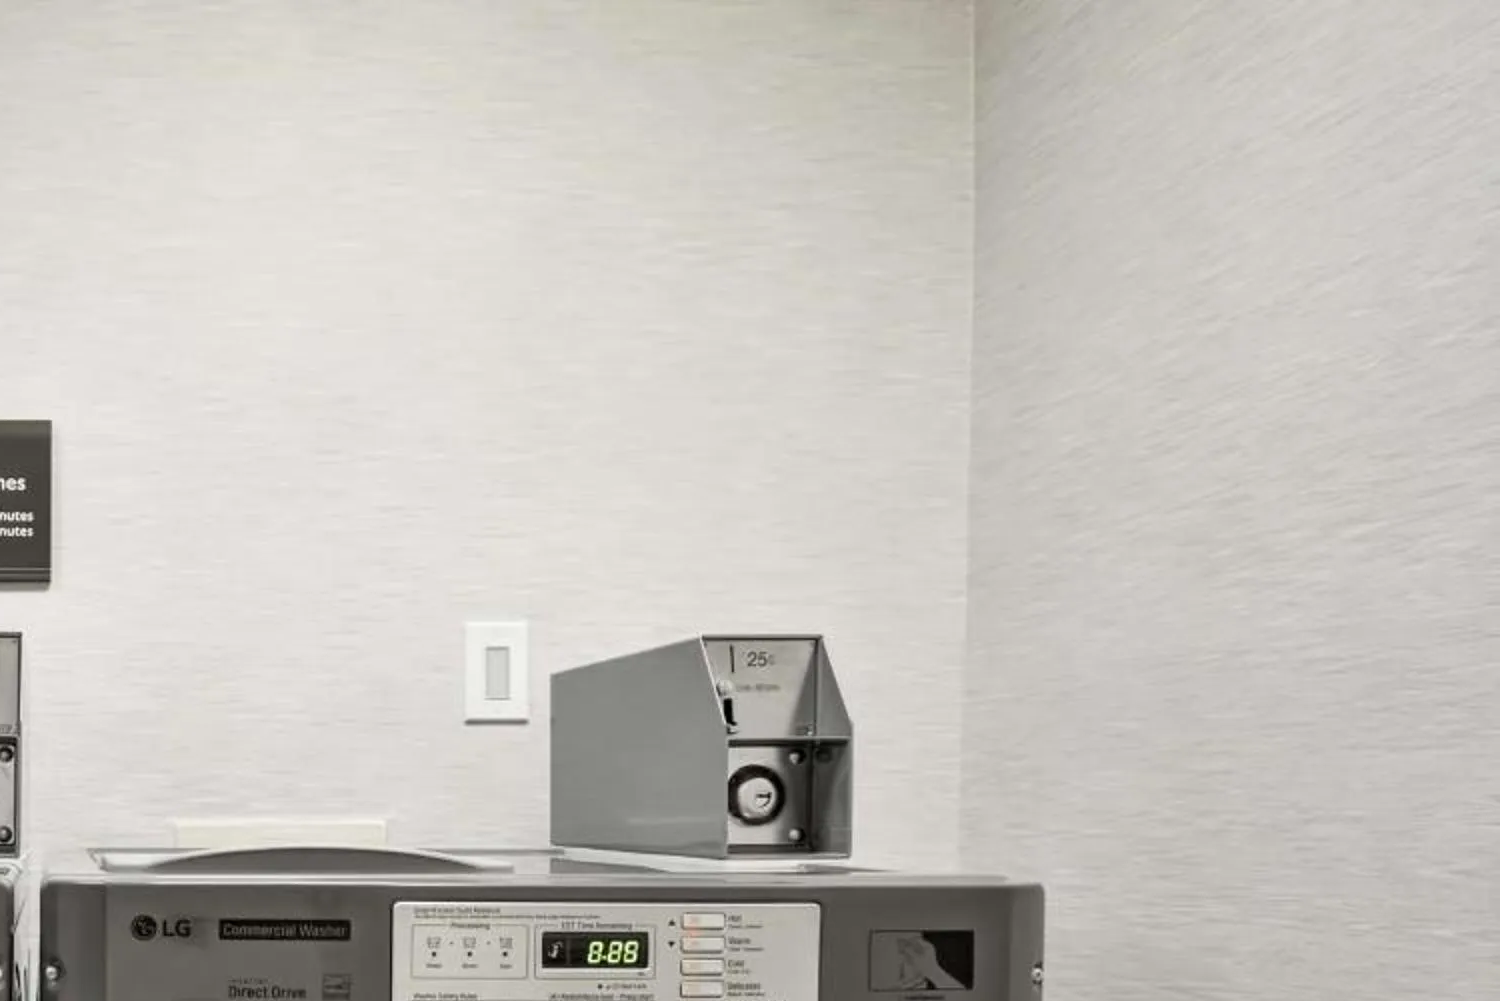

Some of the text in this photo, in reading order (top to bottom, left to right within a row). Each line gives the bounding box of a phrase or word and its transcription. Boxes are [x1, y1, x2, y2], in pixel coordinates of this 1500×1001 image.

[163, 919, 192, 937] LG
[222, 922, 348, 937] Commercial Washer
[228, 985, 268, 999] Direct
[271, 985, 307, 999] Drive
